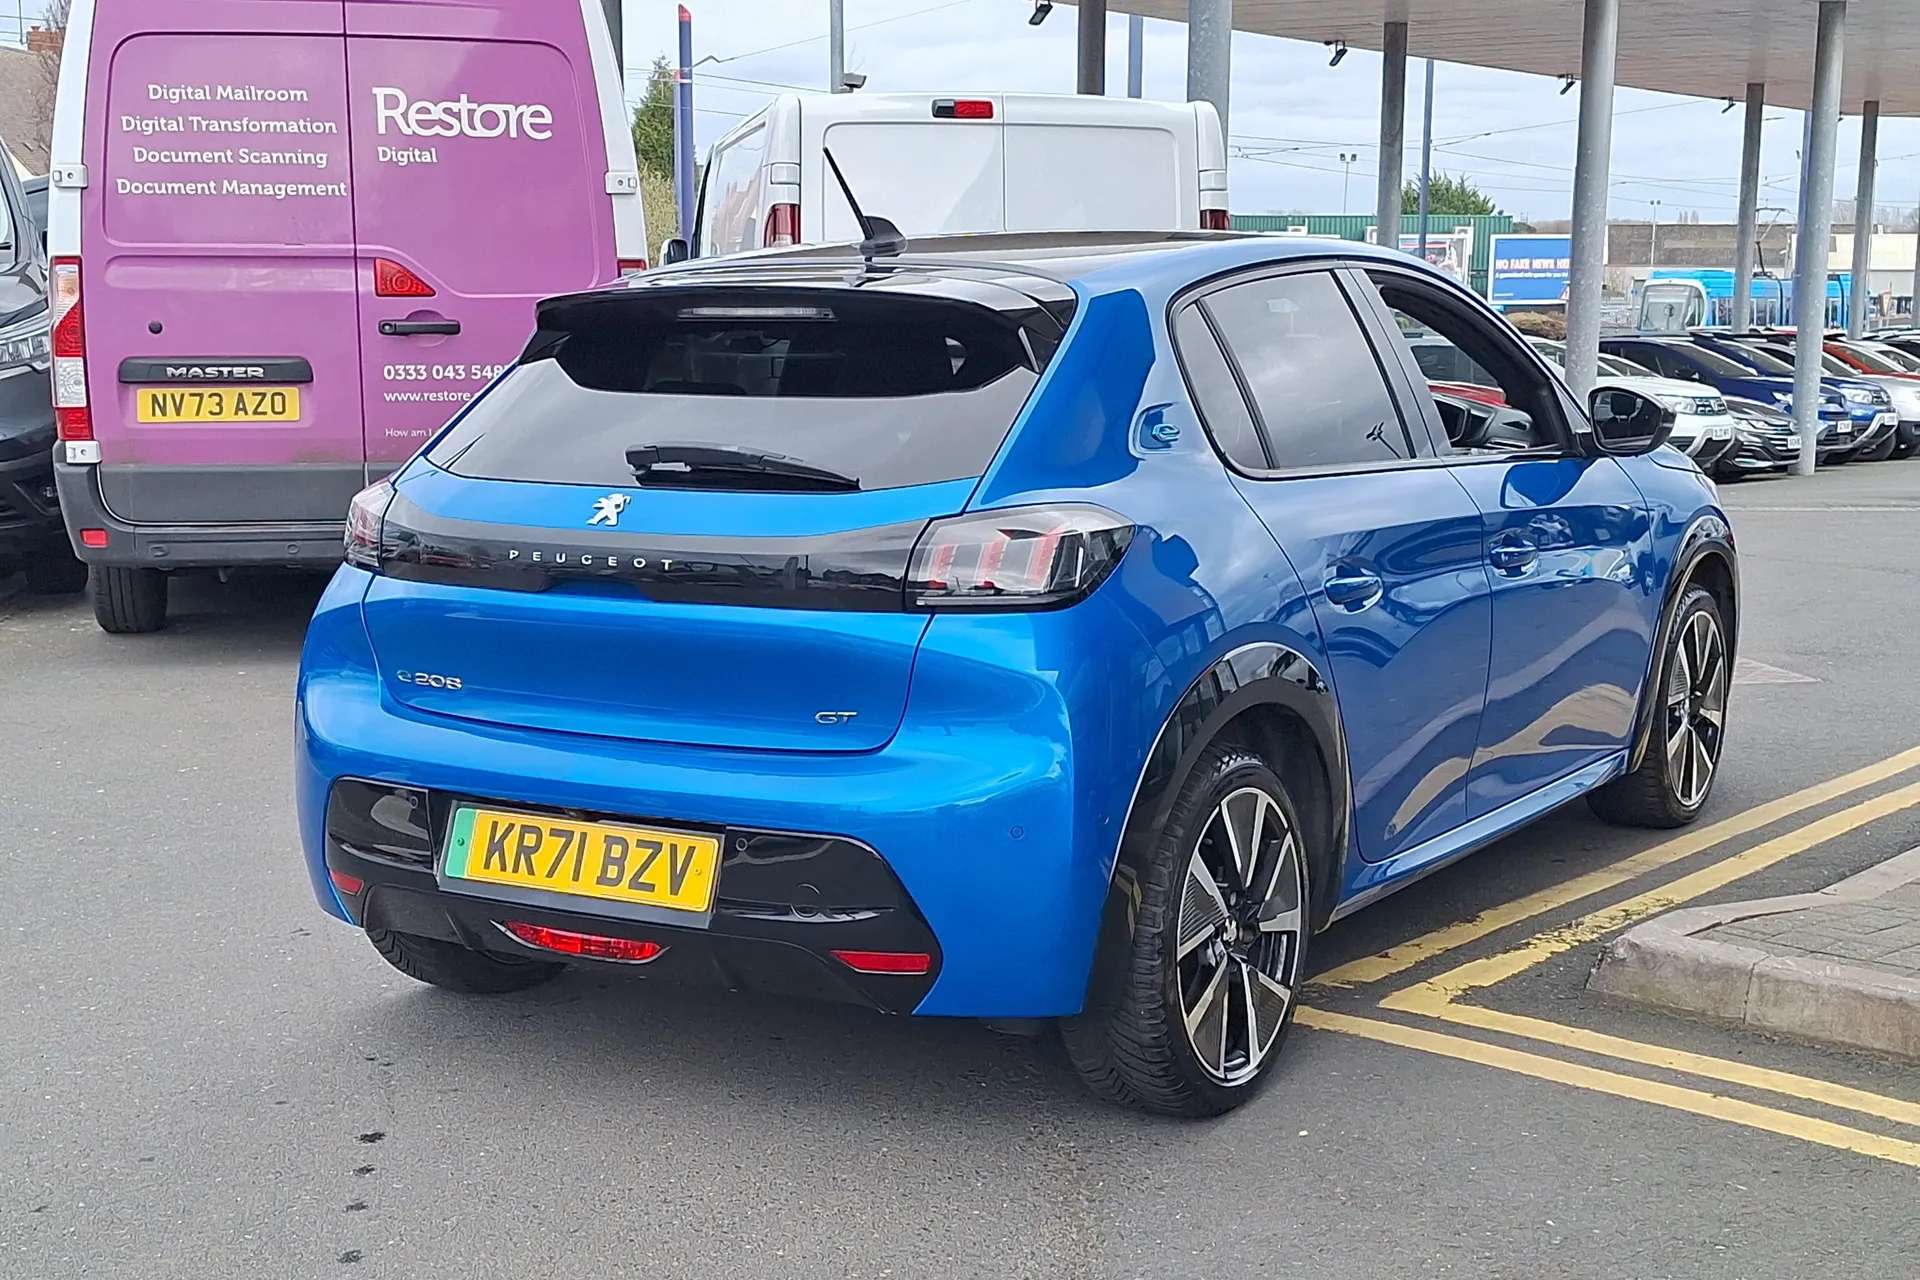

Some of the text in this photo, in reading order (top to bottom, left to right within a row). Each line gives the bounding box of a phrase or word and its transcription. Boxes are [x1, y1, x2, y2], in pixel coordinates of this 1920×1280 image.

[148, 84, 309, 103] Digital Mailroom
[372, 87, 553, 140] Restore
[121, 115, 338, 135] Digital Transformation
[133, 147, 328, 168] Document Scanning
[377, 146, 438, 166] Digital
[116, 178, 347, 199] Document Management
[166, 366, 264, 378] MASTER
[383, 364, 508, 380] 0333 043 548
[151, 392, 287, 417] NV73 AZO
[385, 428, 408, 437] How
[508, 549, 673, 571] PEUGEOT
[815, 711, 858, 724] GT
[483, 820, 696, 896] KR71 BZV
